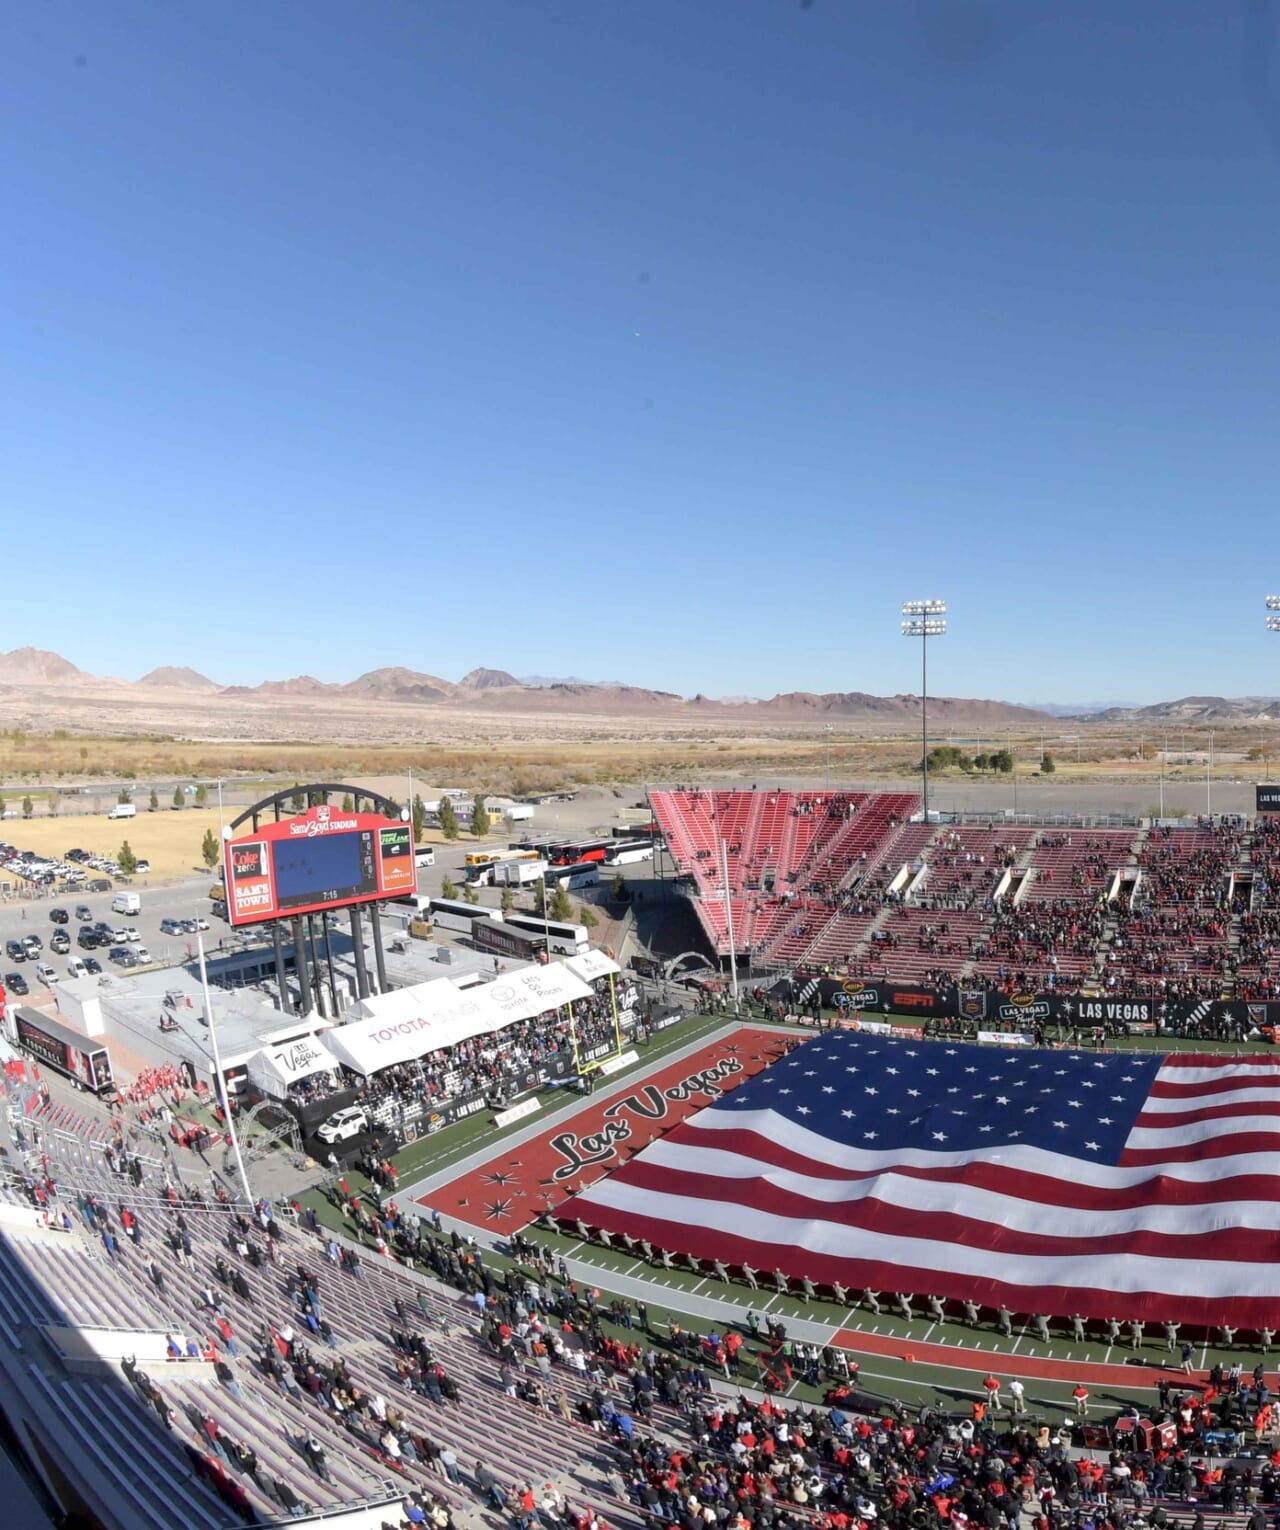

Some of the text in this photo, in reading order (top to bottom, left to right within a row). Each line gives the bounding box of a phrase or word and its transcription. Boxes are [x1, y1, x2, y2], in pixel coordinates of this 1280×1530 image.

[330, 820, 358, 831] STADIUM
[233, 851, 259, 866] Coke
[237, 864, 256, 873] zero
[236, 883, 269, 898] SAM'S
[322, 890, 338, 900] 7:15
[237, 894, 270, 908] TOWN
[851, 993, 874, 1001] VEGAS
[893, 992, 934, 1006] ESPN
[1004, 1006, 1045, 1016] LAS VEGAS
[1079, 1003, 1148, 1020] LAS VEGAS
[368, 1017, 432, 1045] TOYOTA
[26, 1038, 62, 1065] FOOTBALL
[584, 1050, 594, 1062] LAS
[594, 1043, 610, 1058] VEGAS
[274, 1048, 322, 1071] Vegas
[457, 1106, 468, 1118] LAS
[468, 1098, 486, 1114] VEGAS
[550, 1118, 632, 1180] Las
[604, 1056, 744, 1120] Vegas
